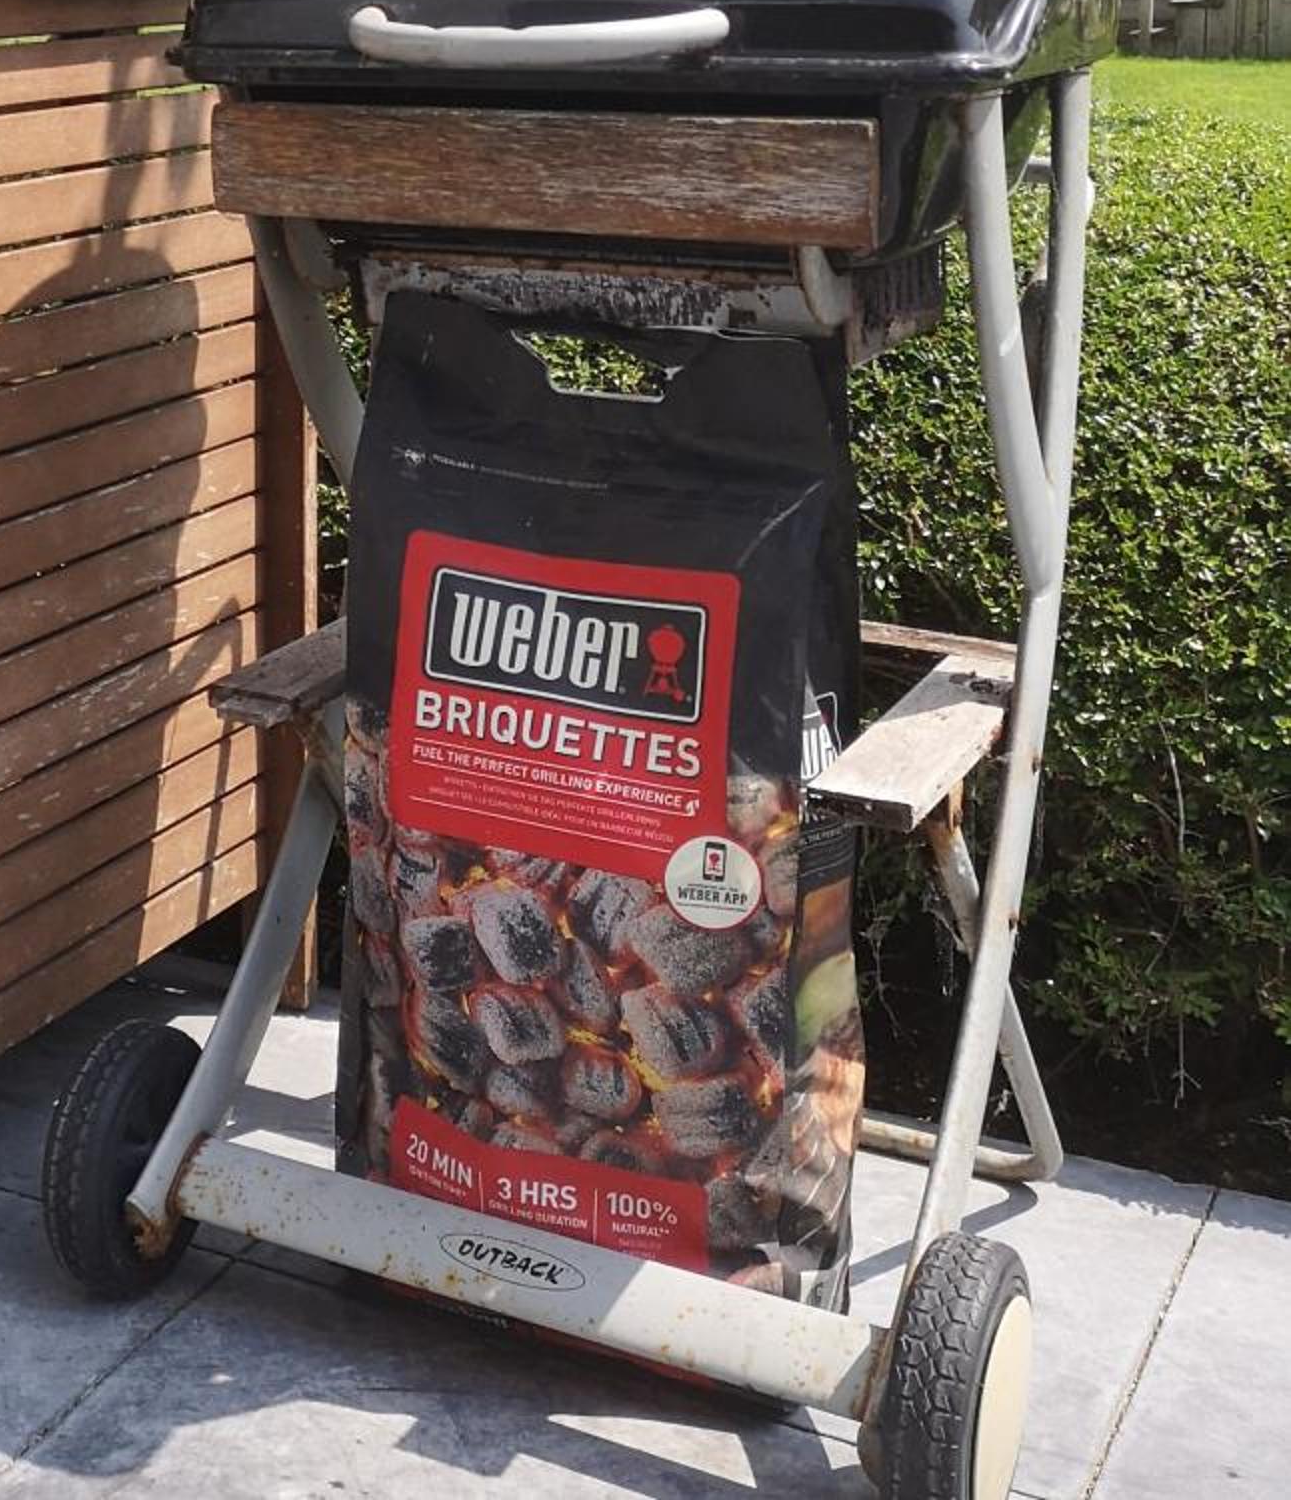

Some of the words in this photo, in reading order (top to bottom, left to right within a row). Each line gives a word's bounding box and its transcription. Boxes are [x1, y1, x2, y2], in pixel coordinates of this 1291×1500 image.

[450, 591, 640, 694] weber
[415, 689, 702, 778] BRIQUETTES
[413, 744, 445, 761] FUEL
[448, 751, 471, 768] THE
[474, 756, 529, 779] PERFECT
[531, 767, 593, 791] GRILLING
[596, 779, 683, 808] EXPERIENCE
[678, 886, 720, 903] WEBER
[725, 891, 748, 905] APP
[406, 1133, 428, 1164] 20
[432, 1147, 473, 1189] MIN
[497, 1177, 513, 1200] 3
[520, 1178, 578, 1211] HRS
[606, 1192, 678, 1226] 100%
[459, 1239, 565, 1285] OUTBACK
